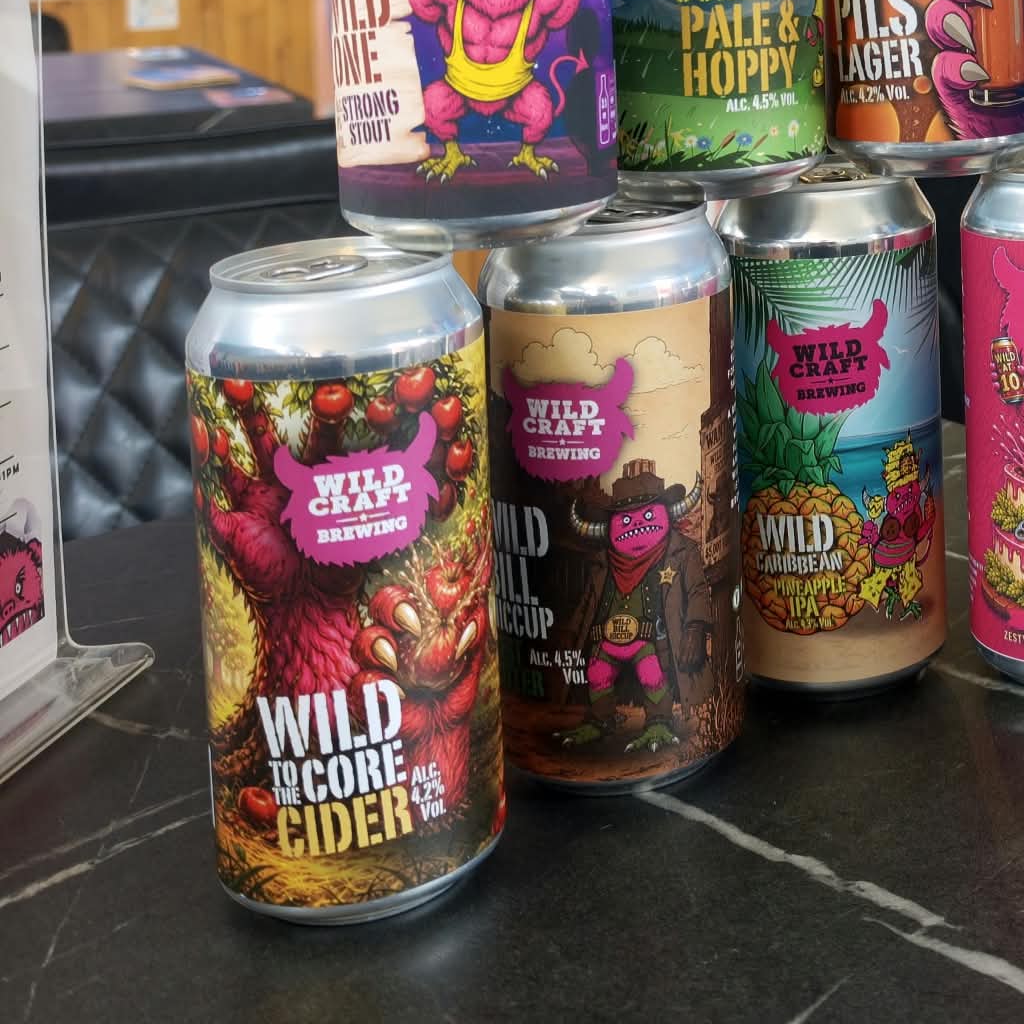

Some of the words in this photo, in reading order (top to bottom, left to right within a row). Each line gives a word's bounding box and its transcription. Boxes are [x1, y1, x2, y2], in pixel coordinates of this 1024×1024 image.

[681, 0, 771, 50] PALE
[778, 0, 801, 44] &
[333, 31, 382, 87] ONE
[682, 45, 798, 97] HOPPY
[839, 37, 924, 82] LAGER
[341, 88, 400, 121] STRONG
[752, 93, 779, 111] 4.5%
[858, 84, 885, 104] 4.2%
[350, 118, 392, 145] STOUT
[793, 339, 861, 362] WILD
[994, 351, 1016, 363] WILD
[789, 356, 867, 378] CRAFT
[1002, 363, 1011, 372] AT
[797, 382, 866, 400] BREWING
[1001, 372, 1020, 392] 10
[526, 398, 600, 419] WILD
[523, 418, 606, 436] CRAFT
[528, 446, 600, 460] BREWING
[313, 464, 404, 497] WILD
[308, 483, 411, 516] CRAFT
[317, 516, 408, 544] BREWING
[757, 514, 834, 552] WILD
[757, 551, 843, 574] CARIBBEAN
[775, 576, 847, 597] PINEAPPLE
[790, 596, 820, 617] IPA
[554, 647, 586, 668] 4.5%
[257, 679, 402, 758] WILD
[268, 759, 298, 787] TO
[272, 787, 302, 806] THE
[302, 740, 407, 803] CORE
[411, 780, 445, 805] 4.2%
[277, 786, 413, 857] CIDER
